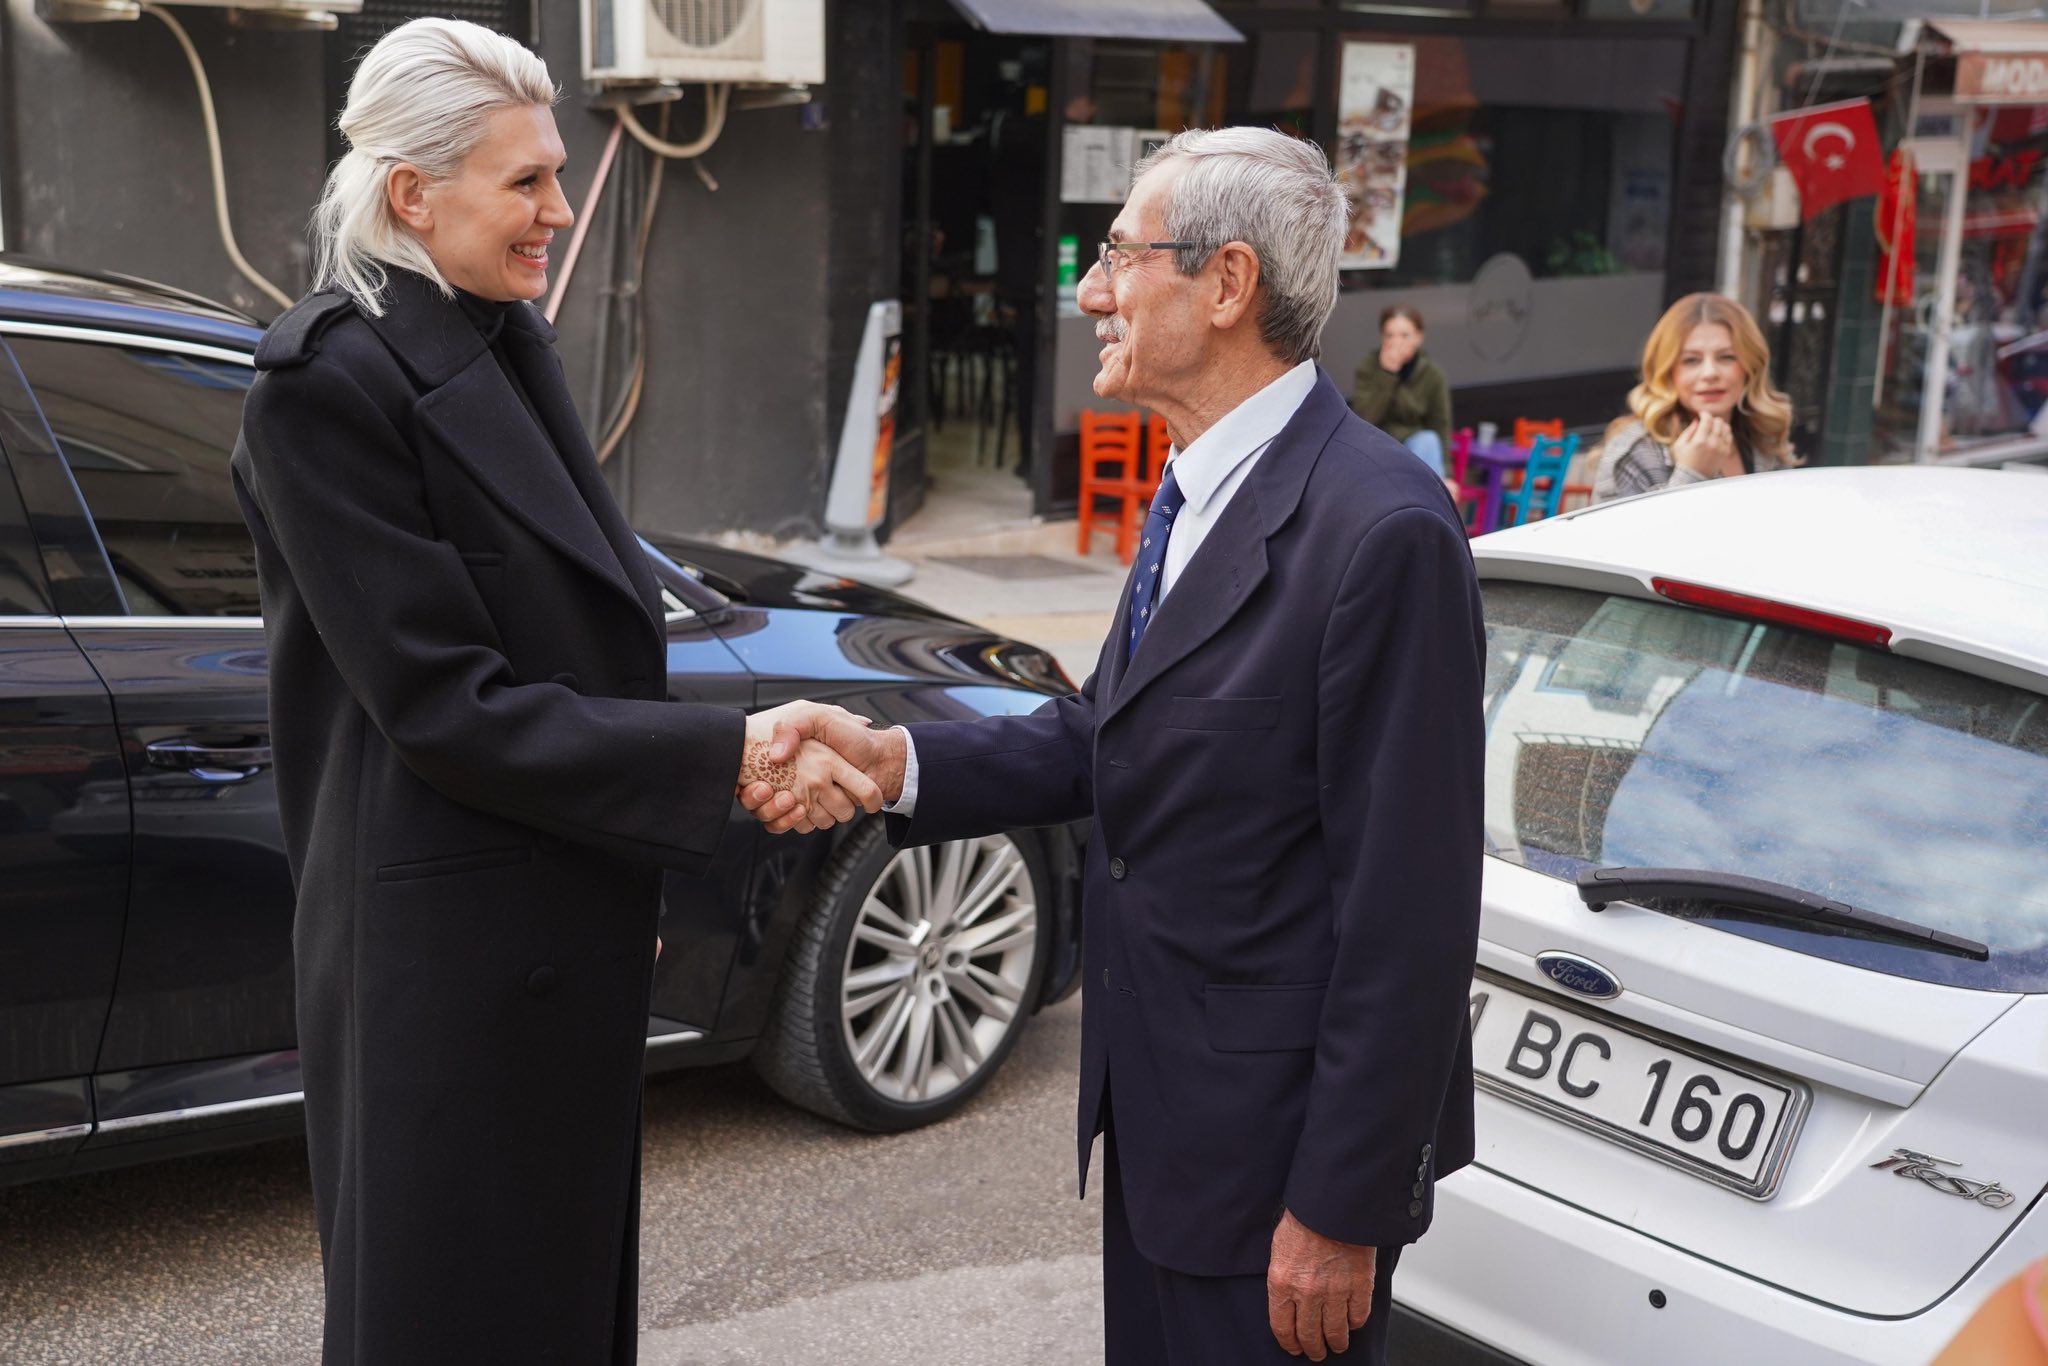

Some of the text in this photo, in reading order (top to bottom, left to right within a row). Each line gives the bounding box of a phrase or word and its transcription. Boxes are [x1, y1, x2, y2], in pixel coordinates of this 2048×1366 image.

[1981, 57, 2048, 95] MOD
[1551, 960, 1600, 992] Ford
[1505, 1009, 1611, 1098] BC
[1639, 1058, 1765, 1160] 160
